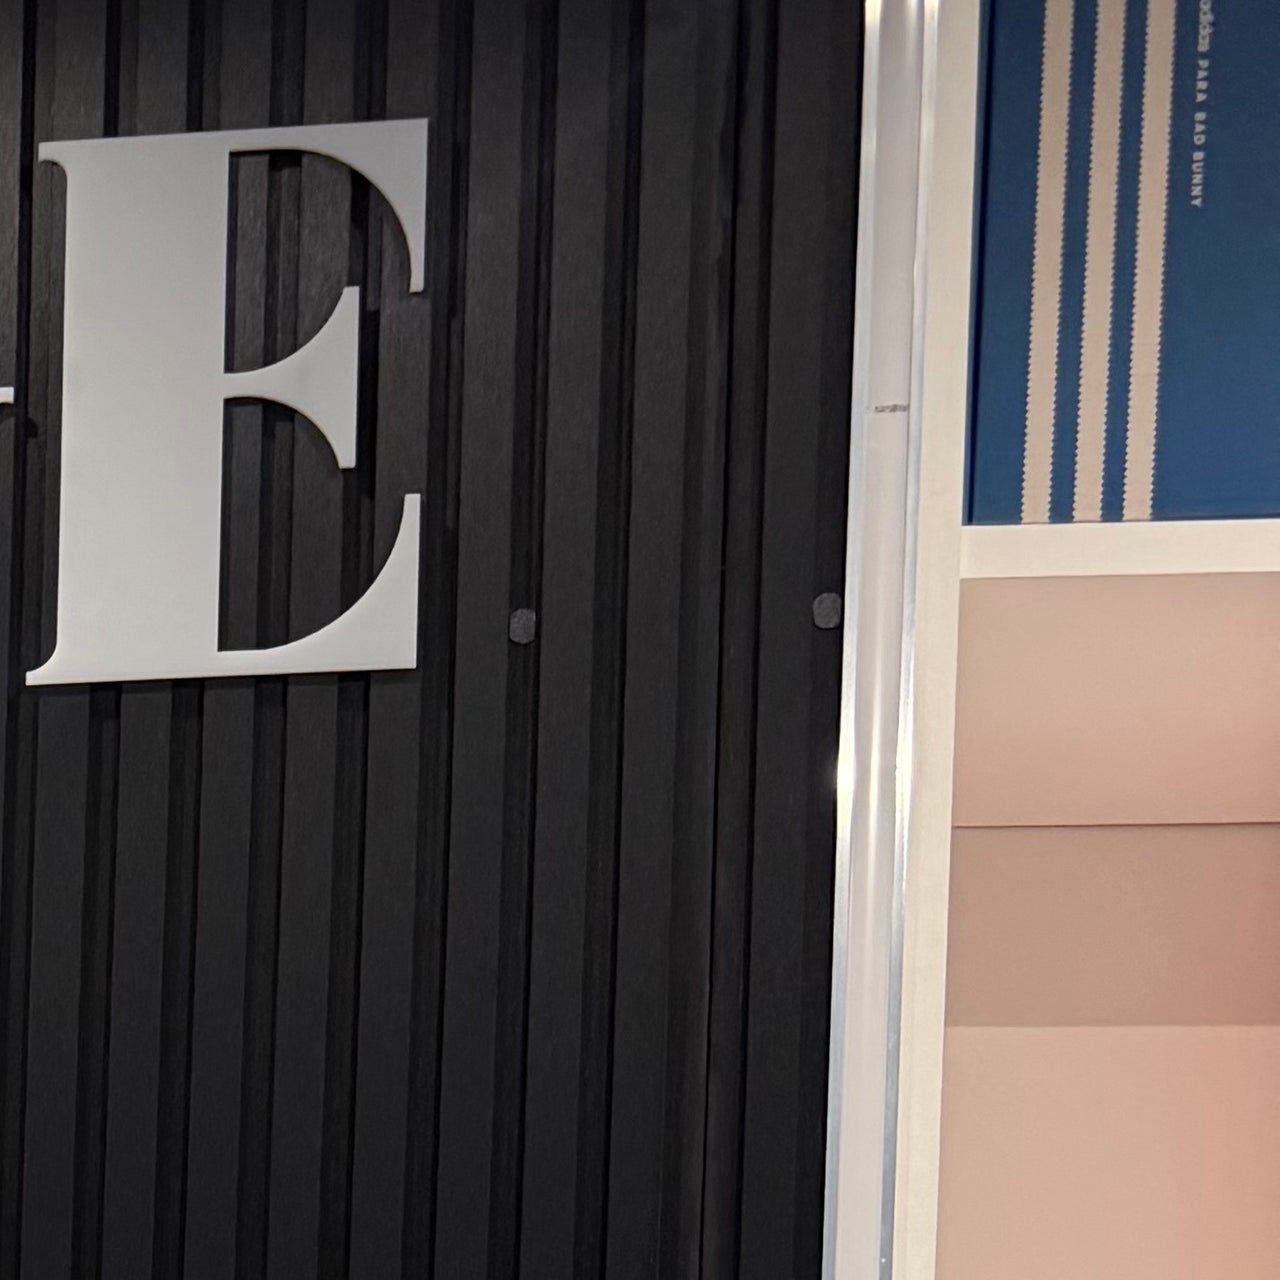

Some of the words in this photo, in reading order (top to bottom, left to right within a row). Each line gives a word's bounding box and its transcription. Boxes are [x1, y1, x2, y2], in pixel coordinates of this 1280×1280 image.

[1196, 59, 1209, 103] PARA
[1193, 111, 1206, 146] BAD
[1190, 151, 1205, 208] BUNNY
